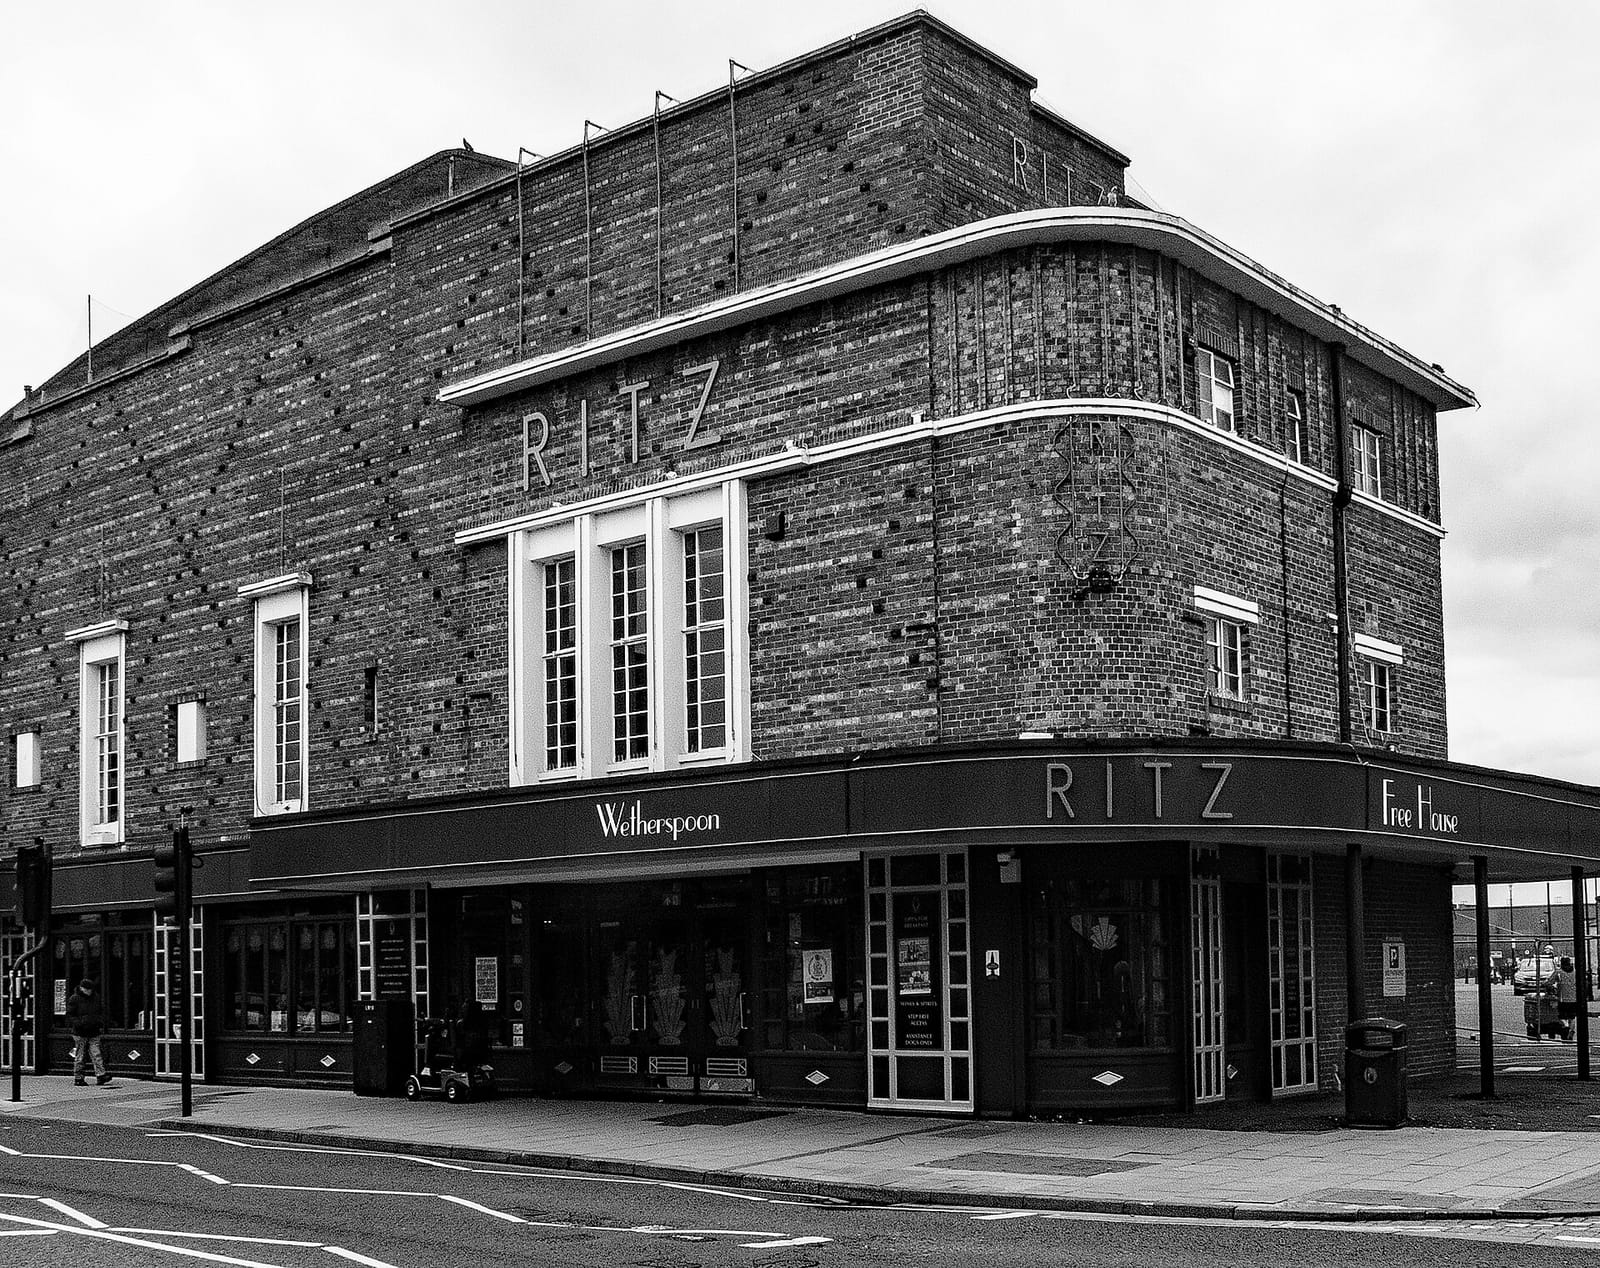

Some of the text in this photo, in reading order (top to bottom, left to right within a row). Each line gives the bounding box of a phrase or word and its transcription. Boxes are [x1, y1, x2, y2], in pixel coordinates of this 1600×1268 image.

[522, 360, 722, 492] RITZ
[1046, 762, 1233, 818] RITZ
[1382, 778, 1458, 834] Free House
[596, 799, 720, 841] Wetherspoon
